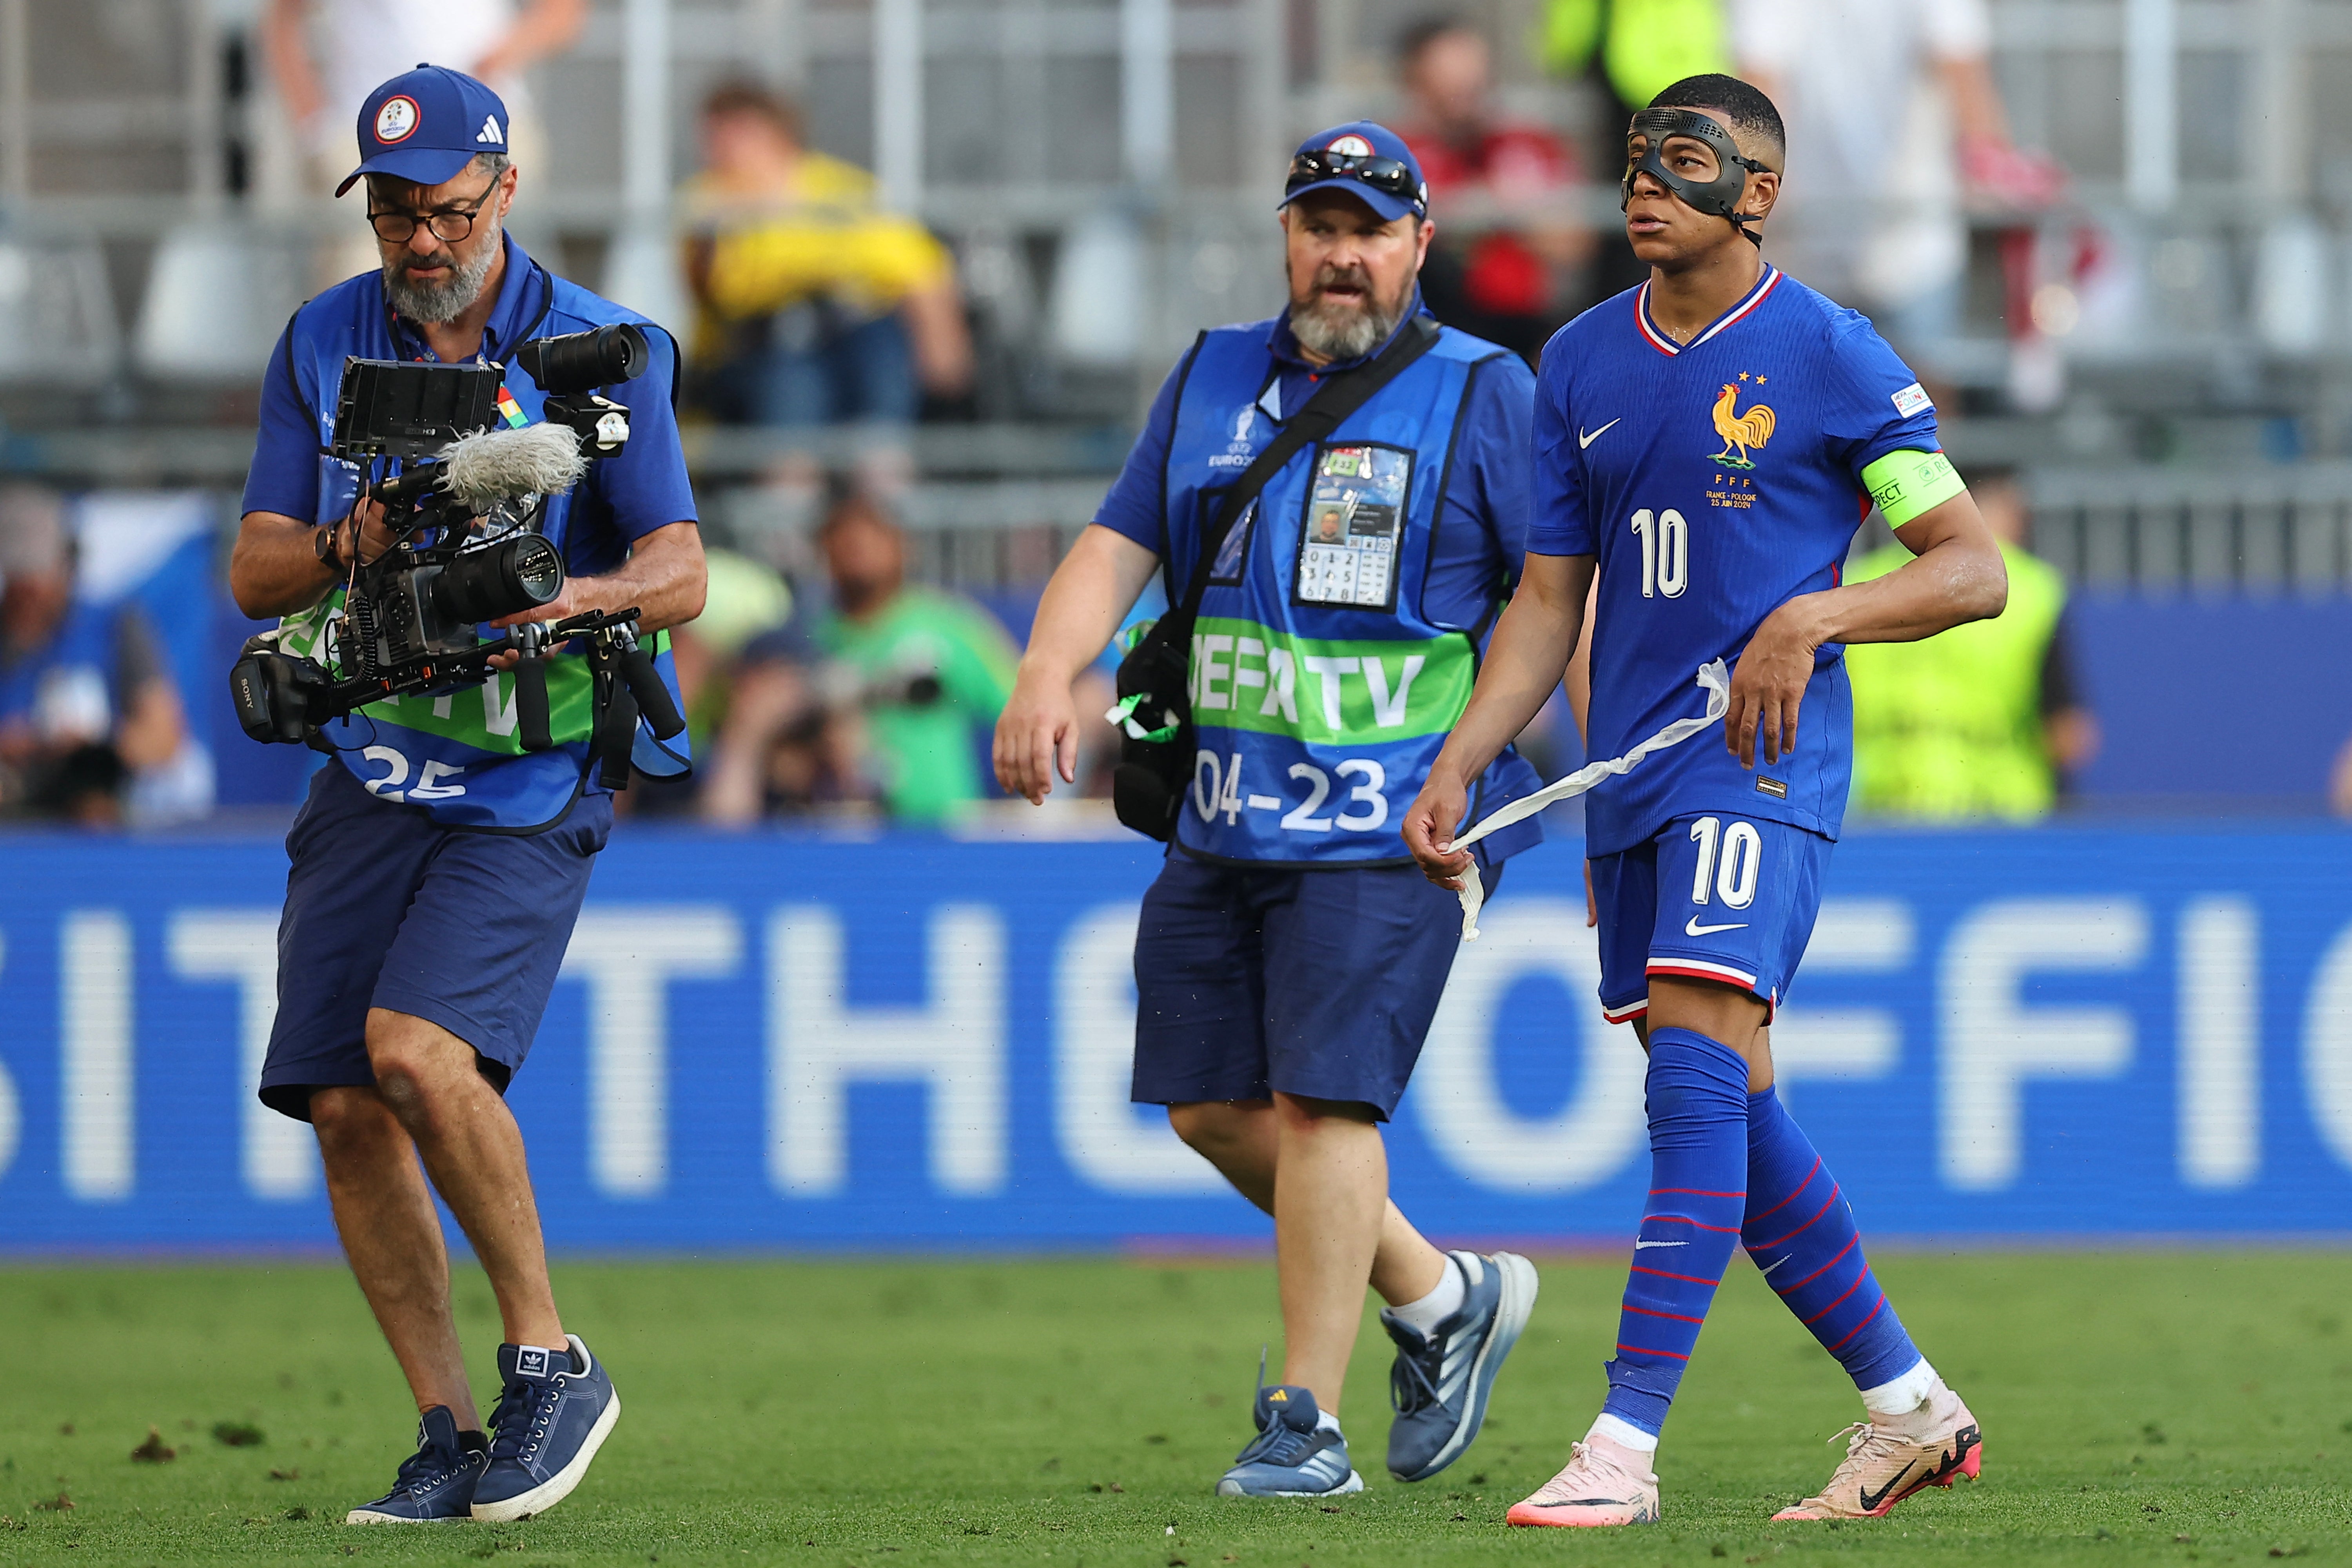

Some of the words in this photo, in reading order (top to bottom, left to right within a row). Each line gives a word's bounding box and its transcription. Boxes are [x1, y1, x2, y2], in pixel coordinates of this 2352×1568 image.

[1894, 392, 1907, 401] UEFA
[1706, 490, 1726, 499] FRANCE
[1731, 493, 1757, 501] POLOGNE
[1329, 552, 1335, 563] 1
[1631, 509, 1687, 598] 10
[241, 678, 254, 708] SONY
[1303, 655, 1426, 731] TV
[363, 745, 466, 803] 25
[1193, 749, 1388, 832] 04-23
[1690, 816, 1762, 910] 10
[0, 907, 329, 1201] IT
